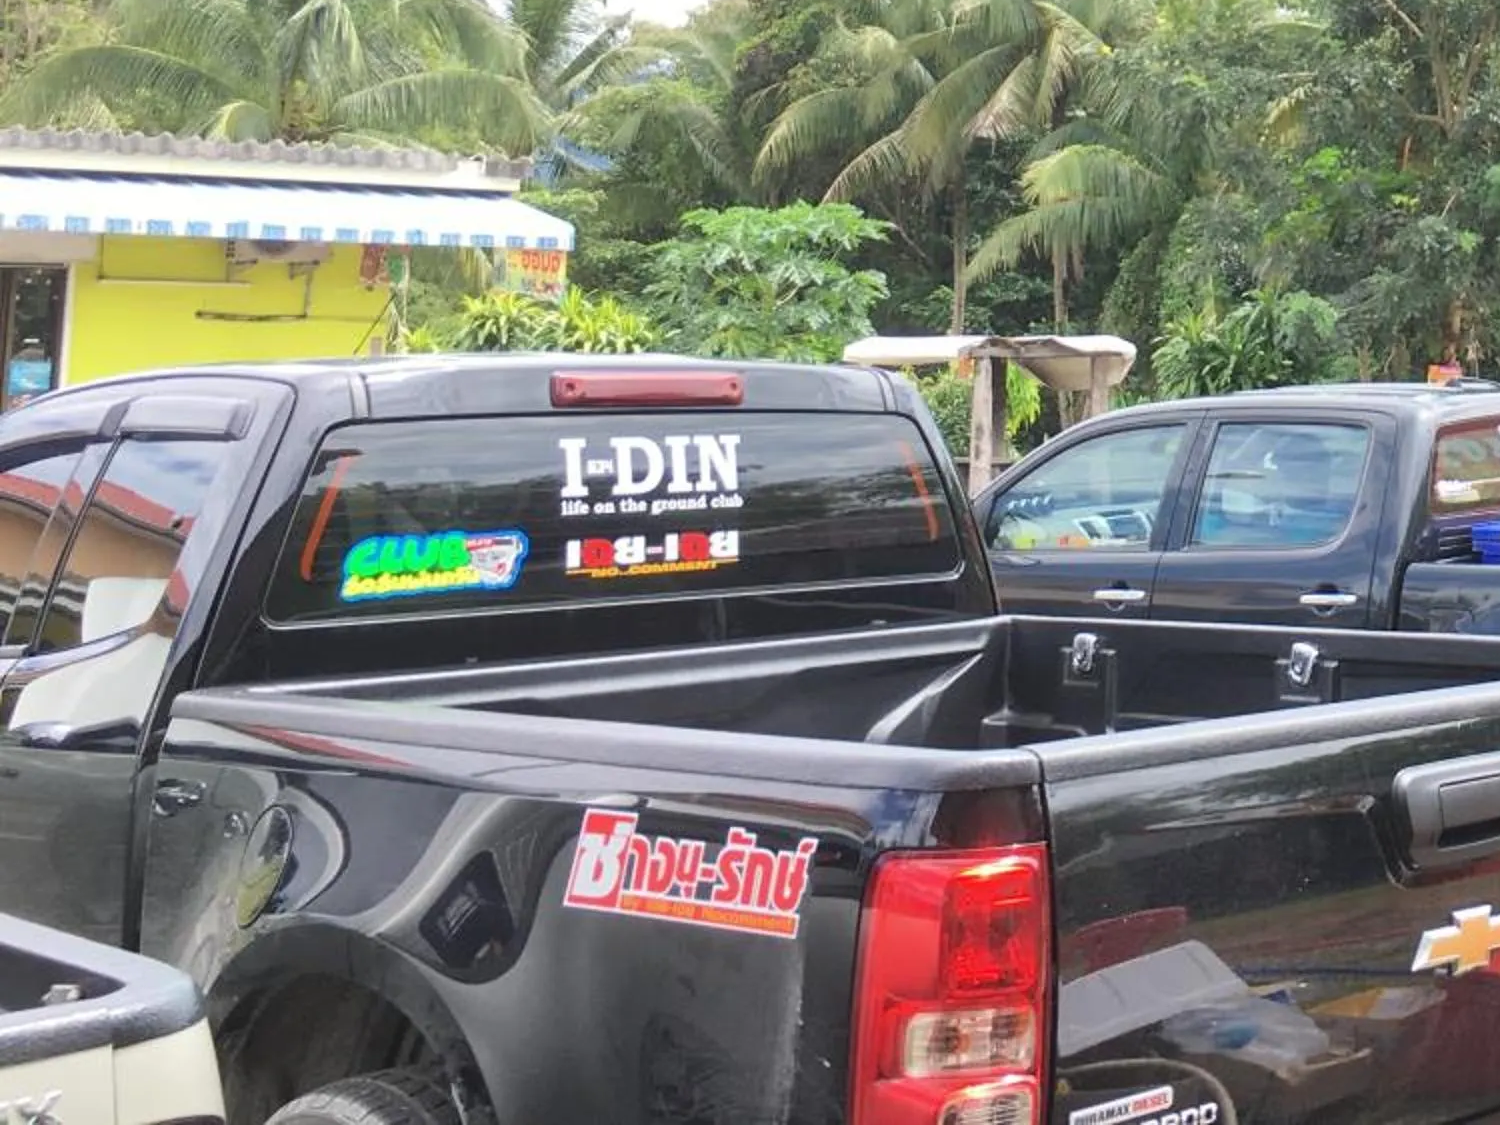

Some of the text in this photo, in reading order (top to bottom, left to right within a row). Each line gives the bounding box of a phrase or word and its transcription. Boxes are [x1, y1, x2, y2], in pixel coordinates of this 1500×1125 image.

[558, 434, 741, 497] I-DIN
[560, 492, 744, 516] life on the ground club
[350, 533, 473, 576] CLUB
